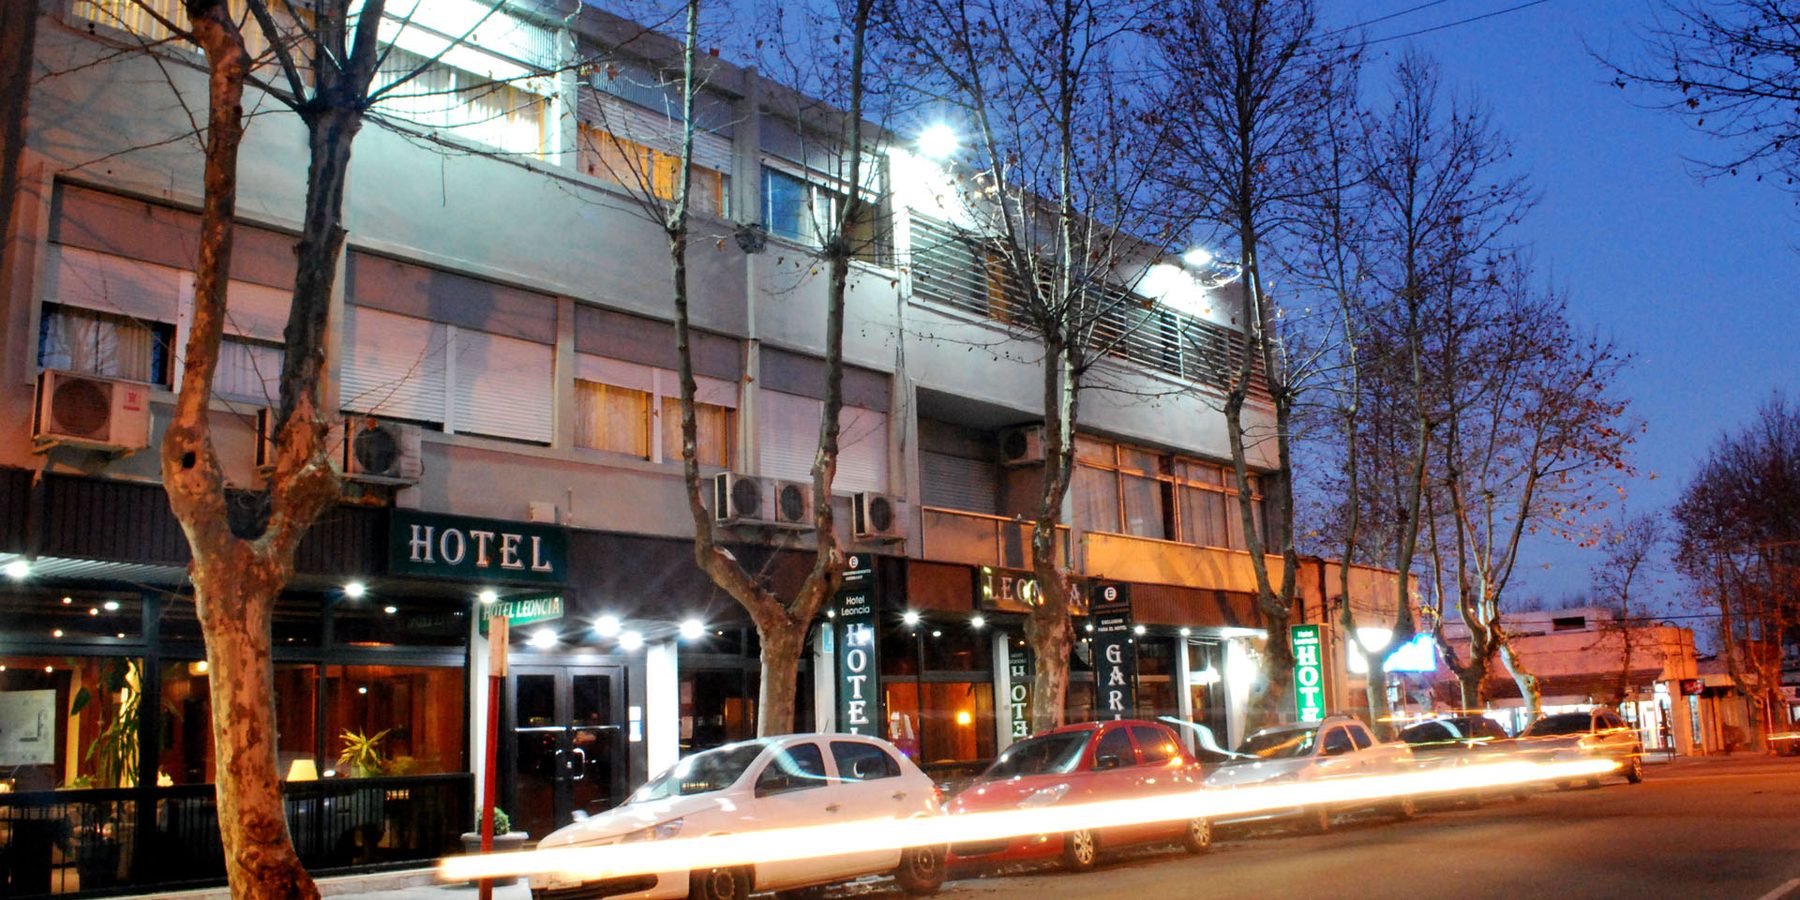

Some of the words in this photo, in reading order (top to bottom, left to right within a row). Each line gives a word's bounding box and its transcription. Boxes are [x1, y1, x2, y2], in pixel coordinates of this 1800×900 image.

[409, 524, 553, 572] HOTEL
[845, 595, 865, 605] Hotel
[988, 575, 1082, 606] LEONA
[483, 601, 515, 621] HOTEL
[516, 597, 560, 618] LEONCIA
[841, 605, 870, 616] Leoncia
